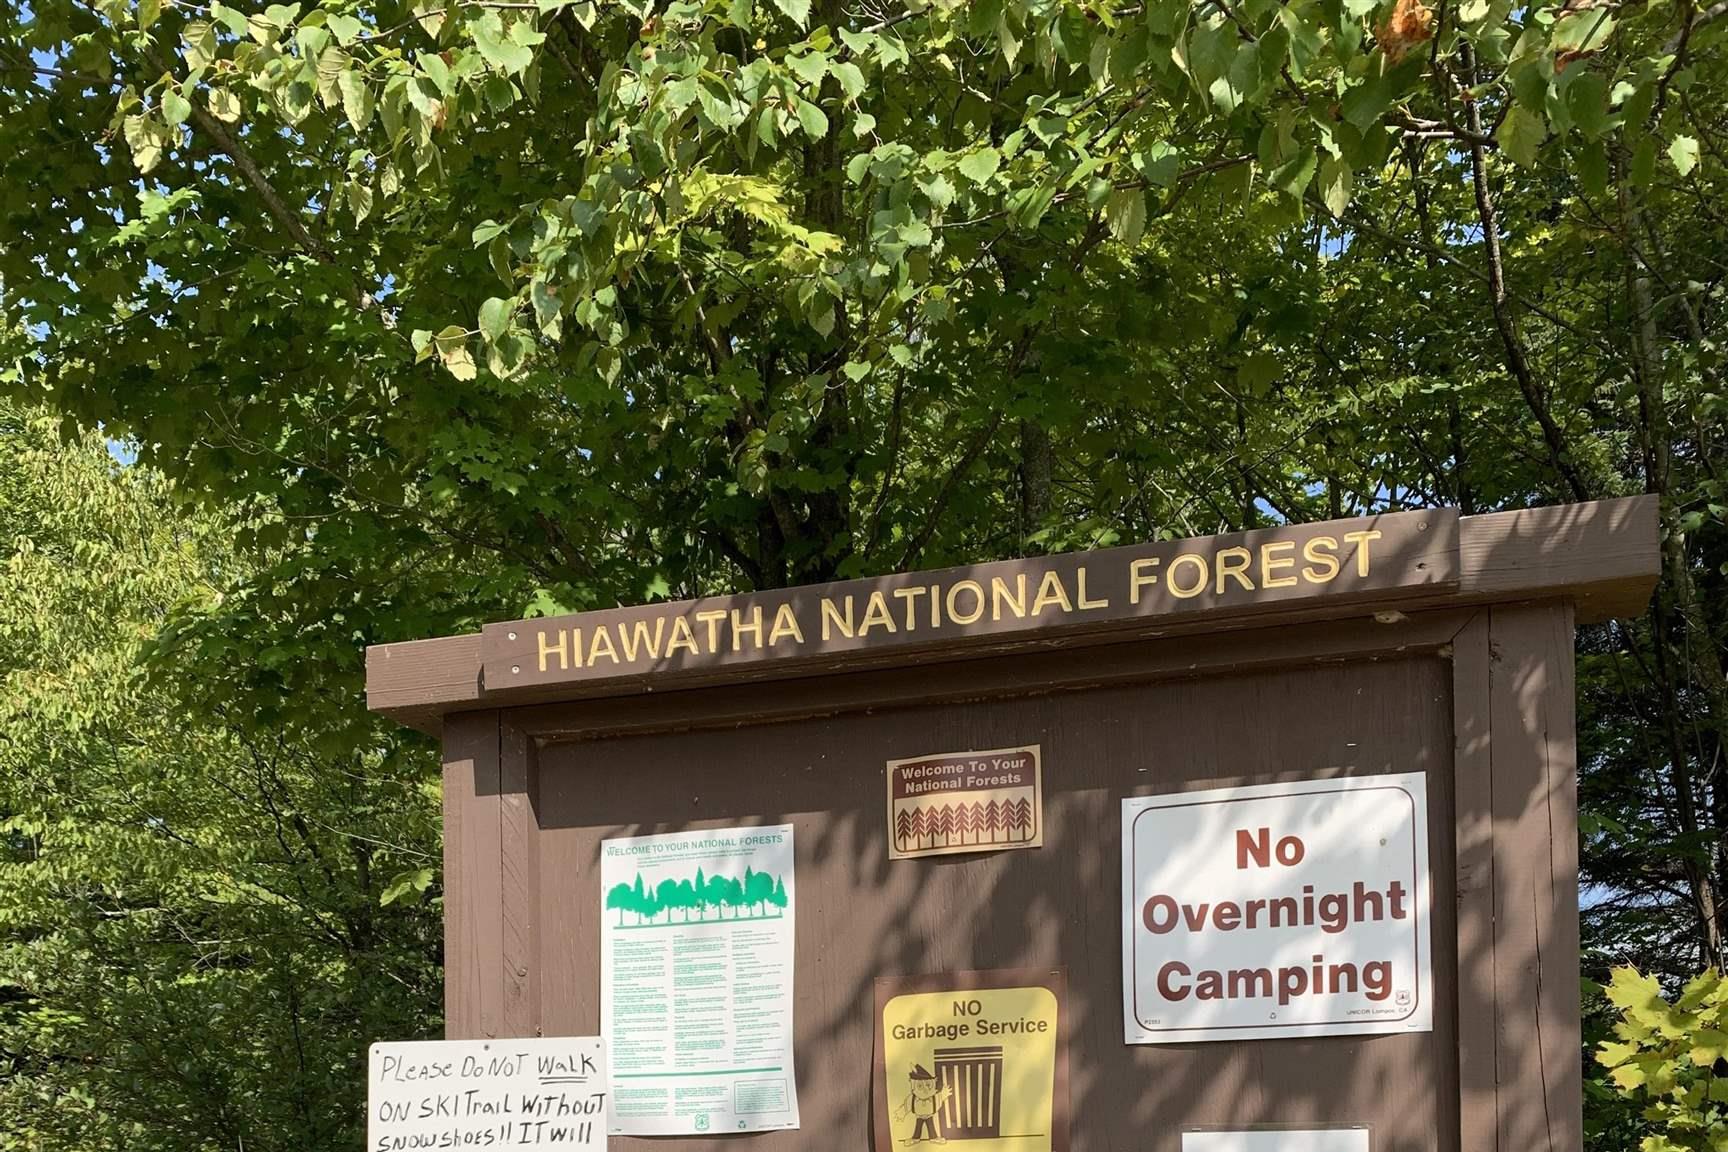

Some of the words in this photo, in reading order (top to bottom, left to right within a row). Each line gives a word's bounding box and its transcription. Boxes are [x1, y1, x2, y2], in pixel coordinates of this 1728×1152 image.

[537, 603, 804, 672] HIAWATHA
[820, 566, 1108, 641] NATIONAL
[1129, 529, 1382, 604] FOREST
[901, 763, 965, 780] Welcome
[969, 760, 987, 772] To
[991, 758, 1026, 770] Your
[905, 776, 961, 794] National
[966, 772, 1021, 788] Forests
[606, 845, 651, 857] WELCOME
[652, 844, 664, 853] TO
[664, 841, 689, 852] YOUR
[691, 837, 736, 849] NATIONAL
[739, 834, 783, 846] FORESTS
[1235, 827, 1305, 869] No
[1142, 880, 1407, 935] Overnight
[1156, 954, 1392, 1006] Camping
[952, 999, 982, 1017] NO
[892, 1021, 969, 1040] Garbage
[976, 1017, 1048, 1036] Service
[379, 1100, 411, 1123] ON
[418, 1094, 459, 1119] SKI
[519, 1120, 549, 1145] IT
